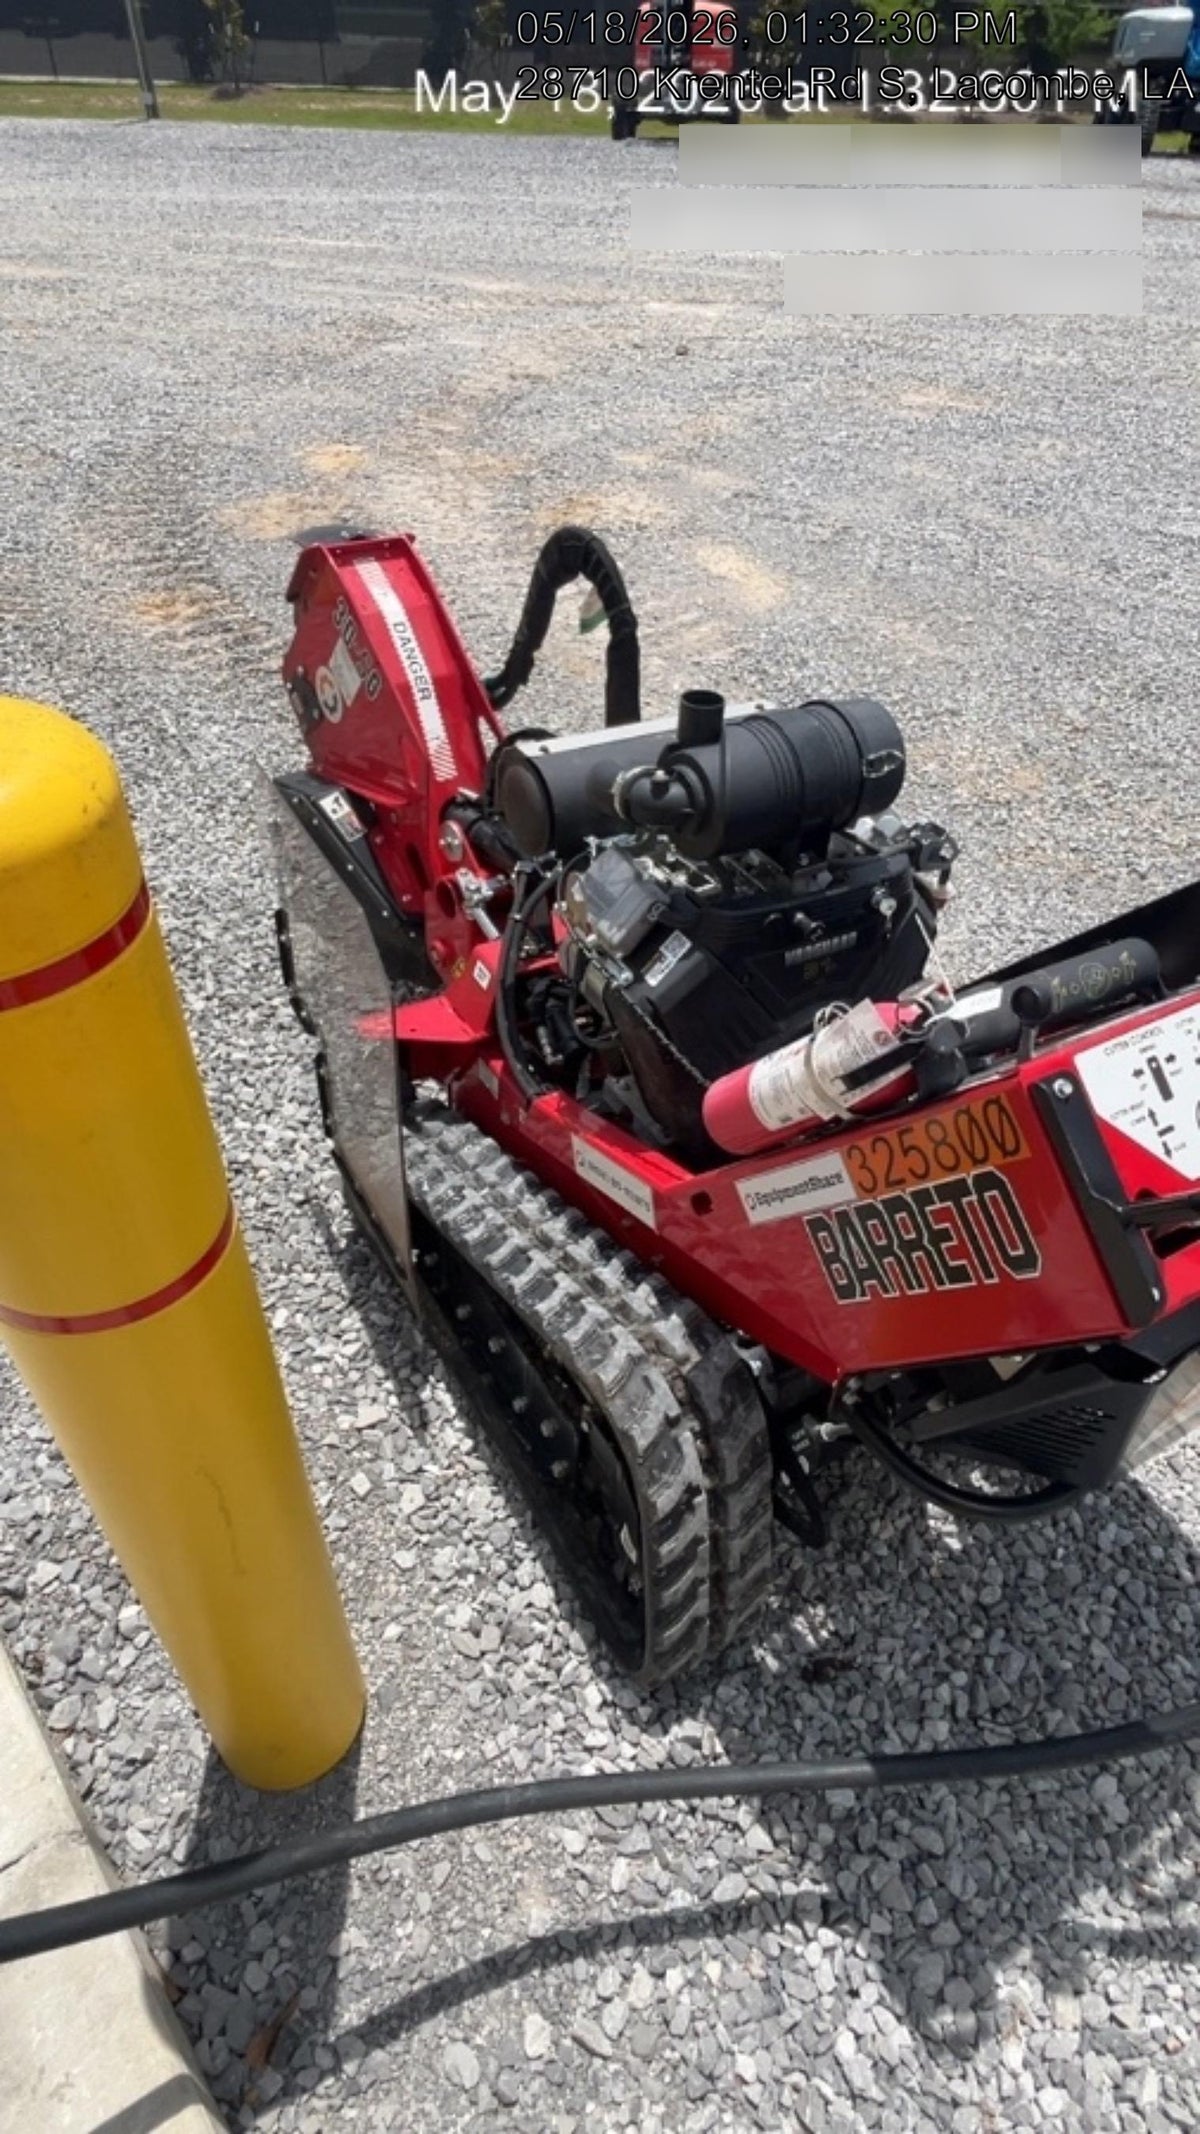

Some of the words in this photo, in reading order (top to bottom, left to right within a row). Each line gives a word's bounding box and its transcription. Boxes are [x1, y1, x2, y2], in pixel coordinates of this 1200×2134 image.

[391, 619, 433, 703] DANGER
[846, 1096, 1022, 1194] 325800
[803, 1165, 1042, 1305] BARRETO
